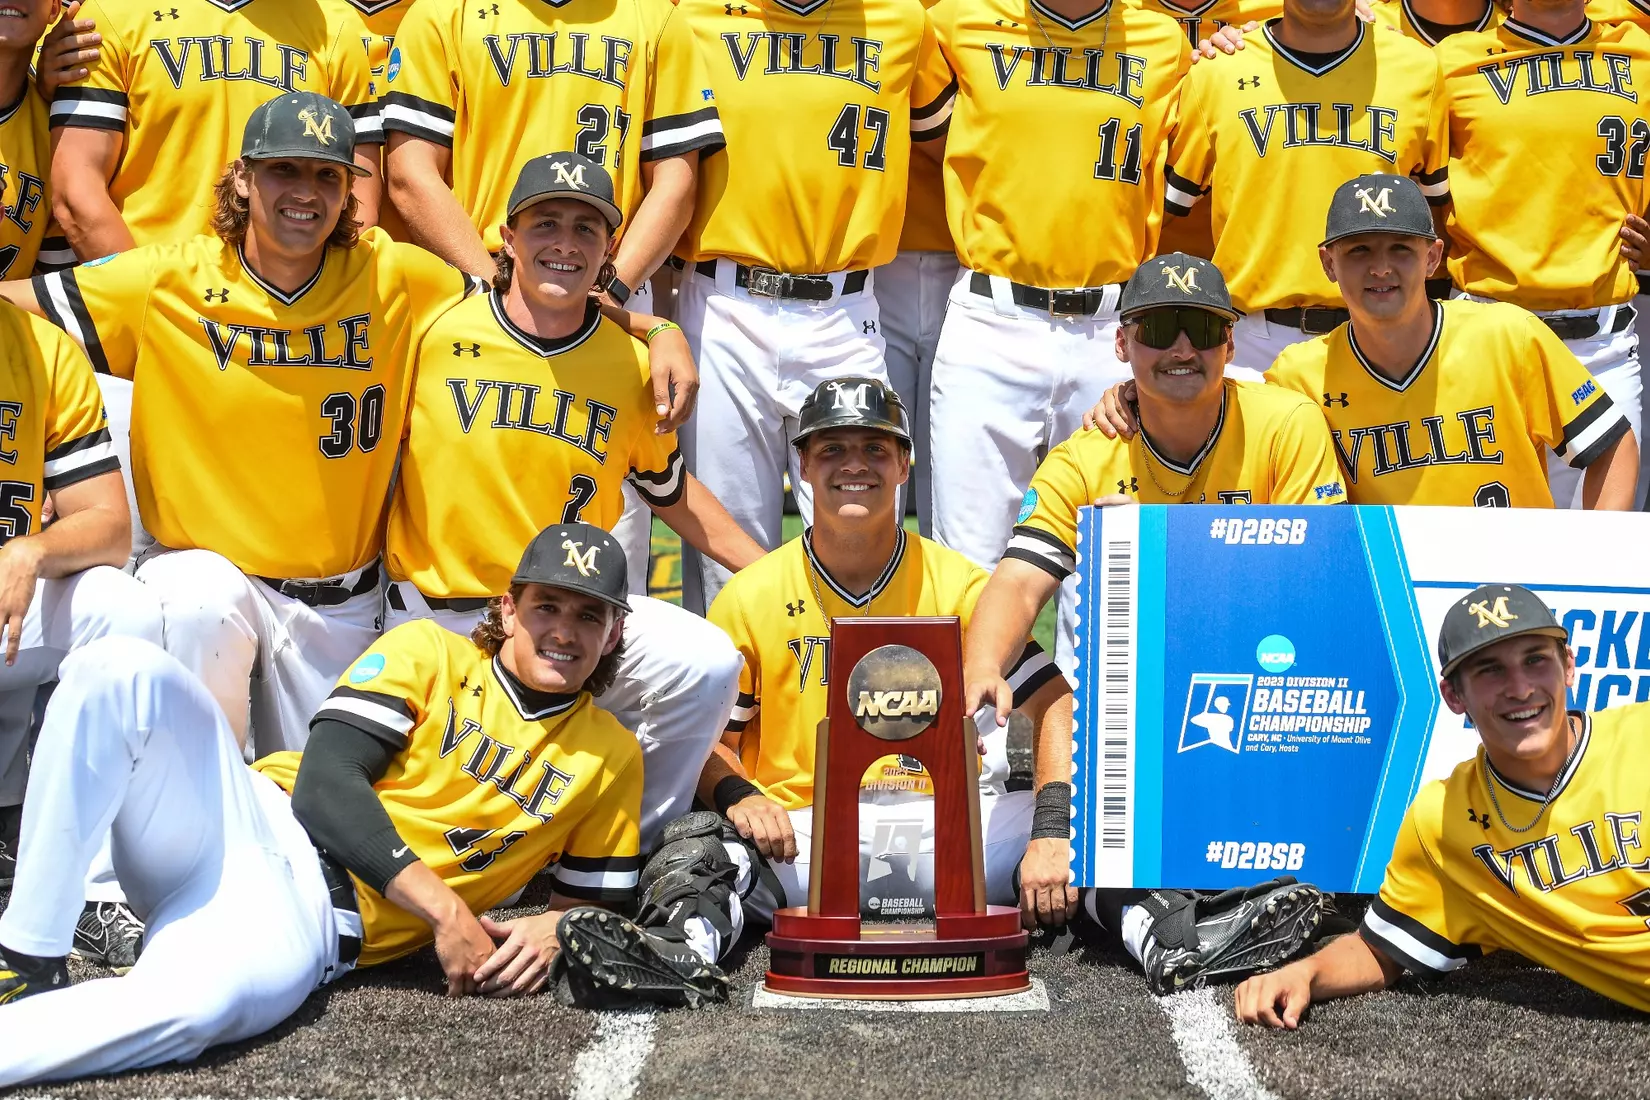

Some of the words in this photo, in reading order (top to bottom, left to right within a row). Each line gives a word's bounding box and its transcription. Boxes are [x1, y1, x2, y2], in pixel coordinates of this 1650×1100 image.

[150, 35, 309, 92] VILLE
[483, 31, 633, 91] VILLE
[720, 31, 883, 94] VILLE
[985, 43, 1147, 109] VILLE
[1478, 51, 1638, 105] VILLE
[827, 103, 890, 172] 47
[1094, 117, 1143, 185] 11
[1239, 102, 1398, 163] VILLE
[1596, 115, 1650, 178] 32
[198, 313, 373, 371] VILLE
[319, 384, 386, 458] 30
[446, 378, 617, 466] VILLE
[1332, 405, 1504, 484] VILLE
[1209, 518, 1308, 545] #D2BSB
[1257, 676, 1285, 686] 2023
[1286, 677, 1335, 688] DIVISION
[1337, 677, 1349, 688] II
[1261, 652, 1295, 664] NCAA
[856, 690, 938, 717] NCAA
[1249, 714, 1371, 734] CHAMPIONSHIP
[1252, 688, 1367, 715] BASEBALL
[439, 697, 575, 825] VILLE
[1245, 743, 1259, 752] and
[1260, 744, 1277, 754] Cary,
[1278, 744, 1299, 753] Hosts
[1247, 733, 1269, 743] CARY,
[1270, 734, 1283, 742] NC
[1287, 734, 1322, 745] University
[1322, 735, 1331, 743] of
[1331, 735, 1353, 744] Mount
[1354, 736, 1371, 744] Olive
[865, 779, 916, 791] DIVISION
[1206, 841, 1306, 870] #D2BSB
[1472, 811, 1650, 898] VILLE
[880, 907, 926, 915] CHAMPIONSHIP
[881, 898, 924, 908] BASEBALL
[829, 957, 898, 975] REGIONAL
[901, 956, 977, 974] CHAMPION
